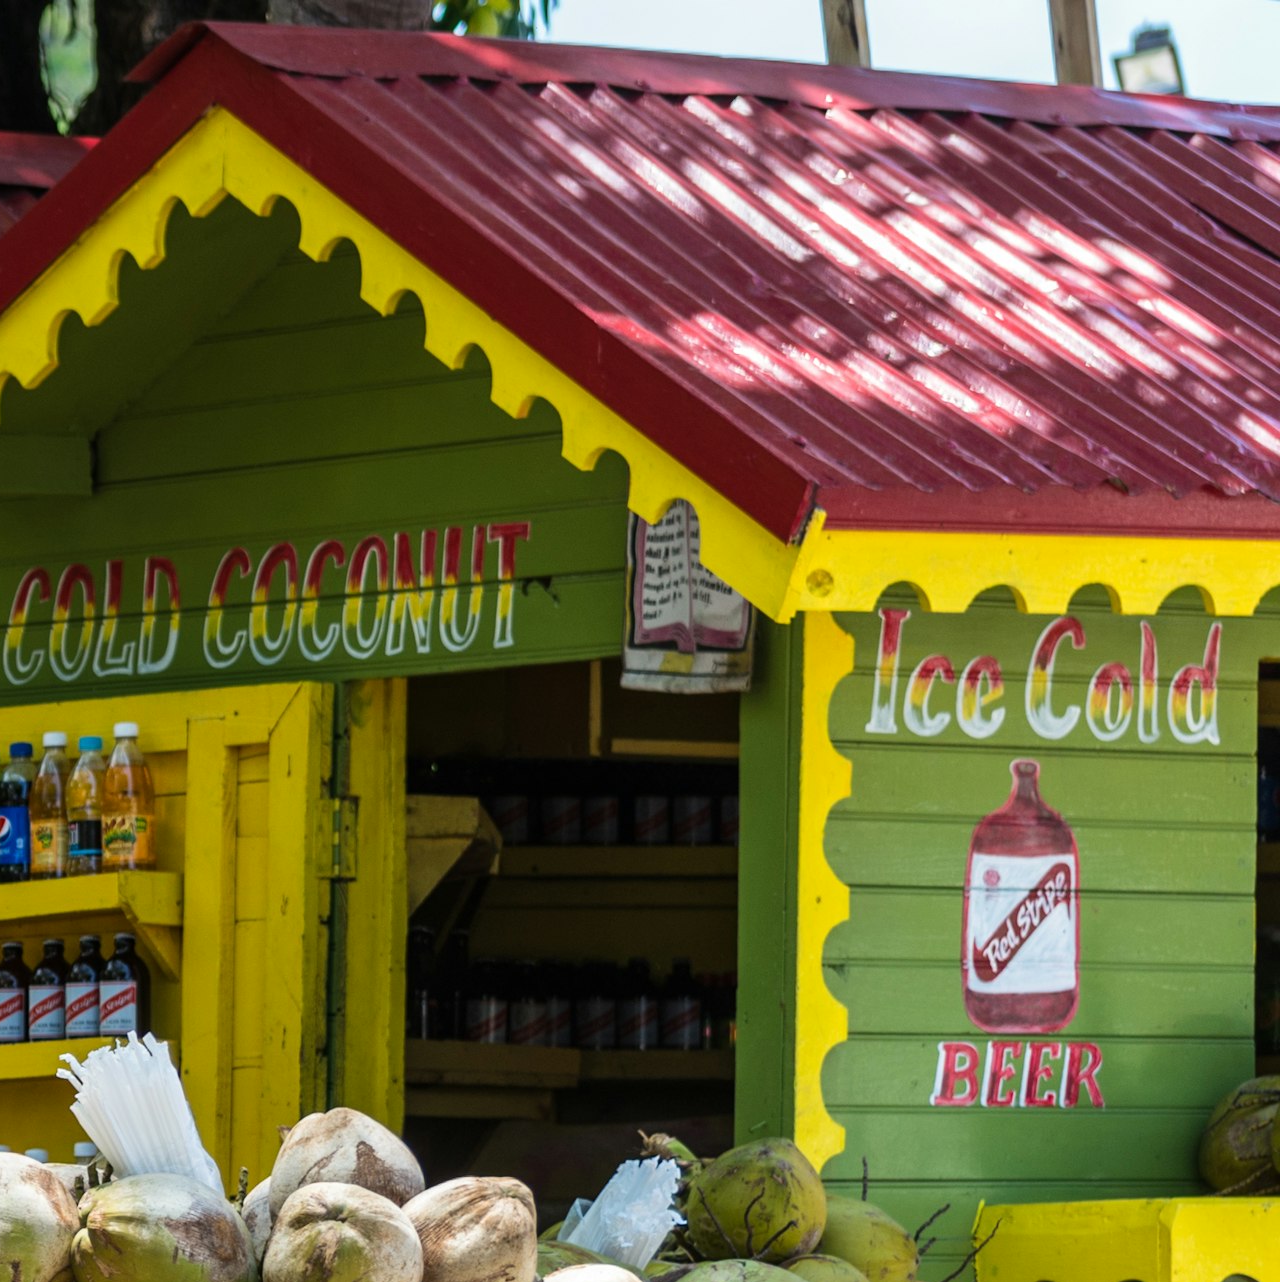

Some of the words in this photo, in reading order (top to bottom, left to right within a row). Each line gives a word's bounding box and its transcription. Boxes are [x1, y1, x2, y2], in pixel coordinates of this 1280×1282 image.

[3, 556, 181, 686] COLD
[202, 521, 531, 670] COCONUT
[865, 607, 1006, 739] Ice
[1025, 615, 1223, 746] Cold
[983, 918, 1021, 974] Red
[1016, 870, 1069, 936] Stripe
[929, 1040, 1105, 1109] BEER
